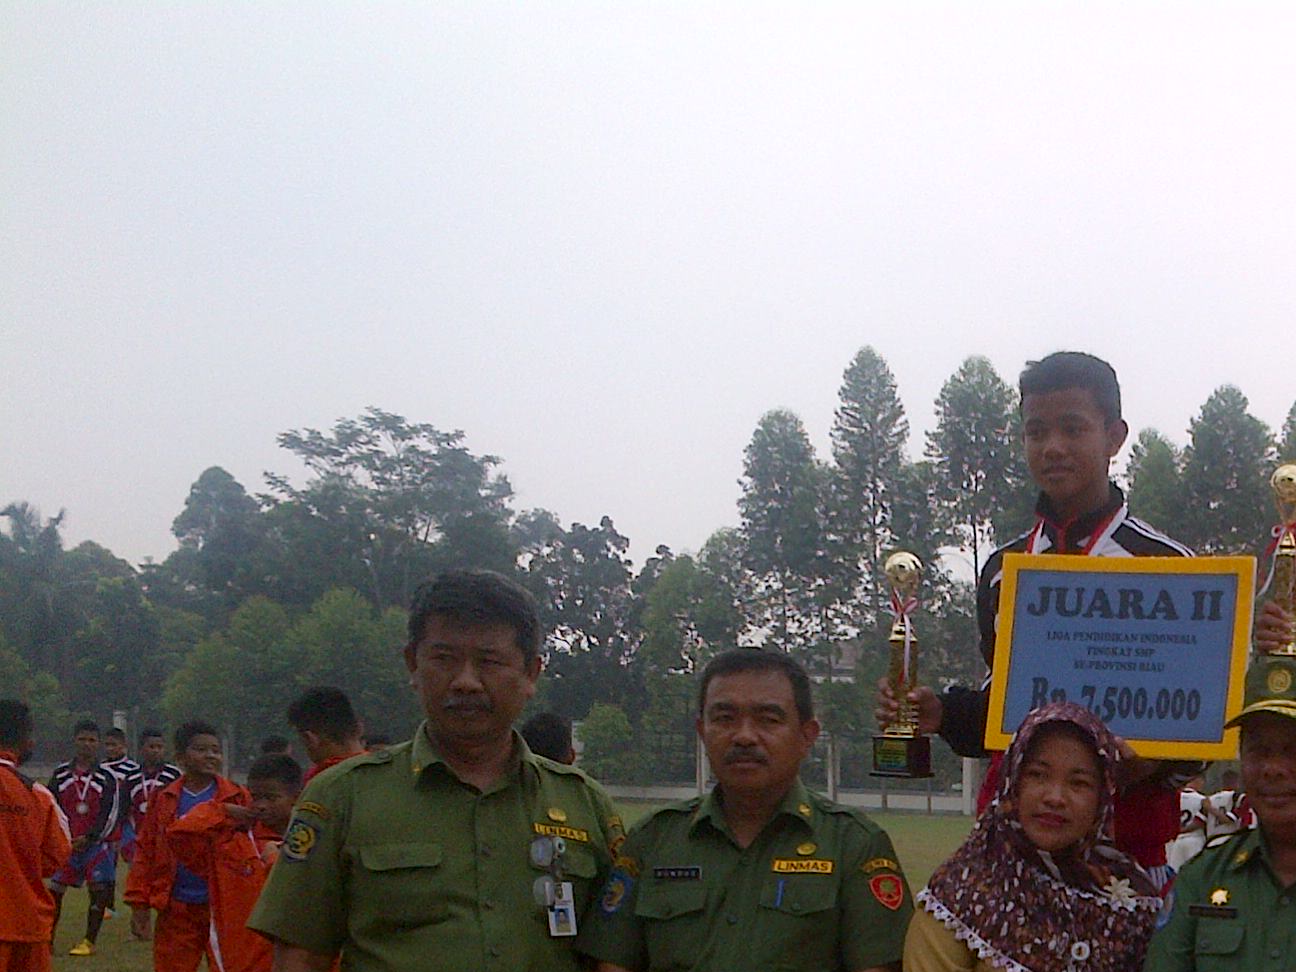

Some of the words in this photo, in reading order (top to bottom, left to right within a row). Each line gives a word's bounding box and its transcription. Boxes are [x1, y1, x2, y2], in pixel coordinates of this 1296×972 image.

[1027, 587, 1180, 621] JUARA
[1191, 590, 1224, 621] II
[1048, 632, 1070, 642] LIGA
[1074, 632, 1139, 643] PENDIDIKAN
[1141, 634, 1198, 645] INDONESIA
[1088, 647, 1132, 657] TINGKAT
[1135, 648, 1156, 658] SMP
[1140, 663, 1165, 673] RIAU
[777, 860, 829, 872] LINMAS
